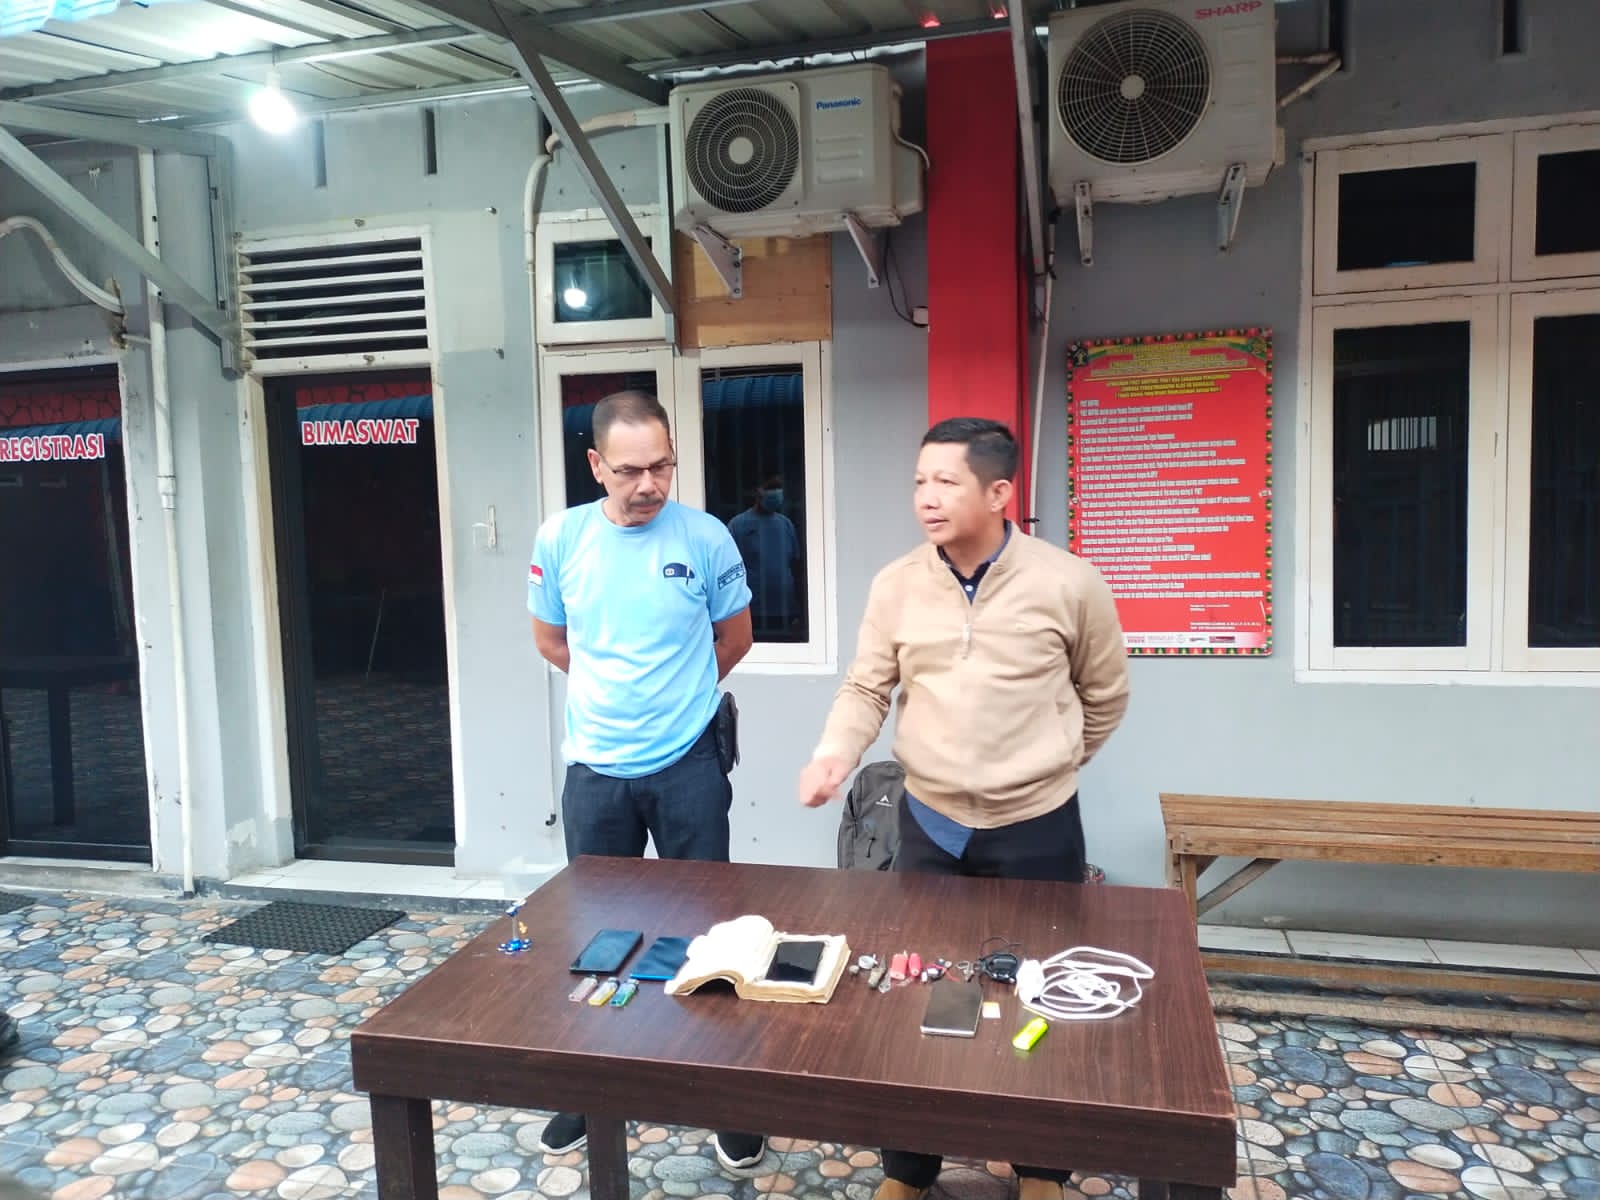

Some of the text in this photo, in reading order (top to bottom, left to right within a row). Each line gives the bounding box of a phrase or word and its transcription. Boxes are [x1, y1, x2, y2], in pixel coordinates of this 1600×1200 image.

[1195, 1, 1262, 19] SHARP
[816, 97, 862, 110] Panasonic
[302, 419, 419, 445] BIMASWAT
[0, 433, 105, 461] REGISTRASI
